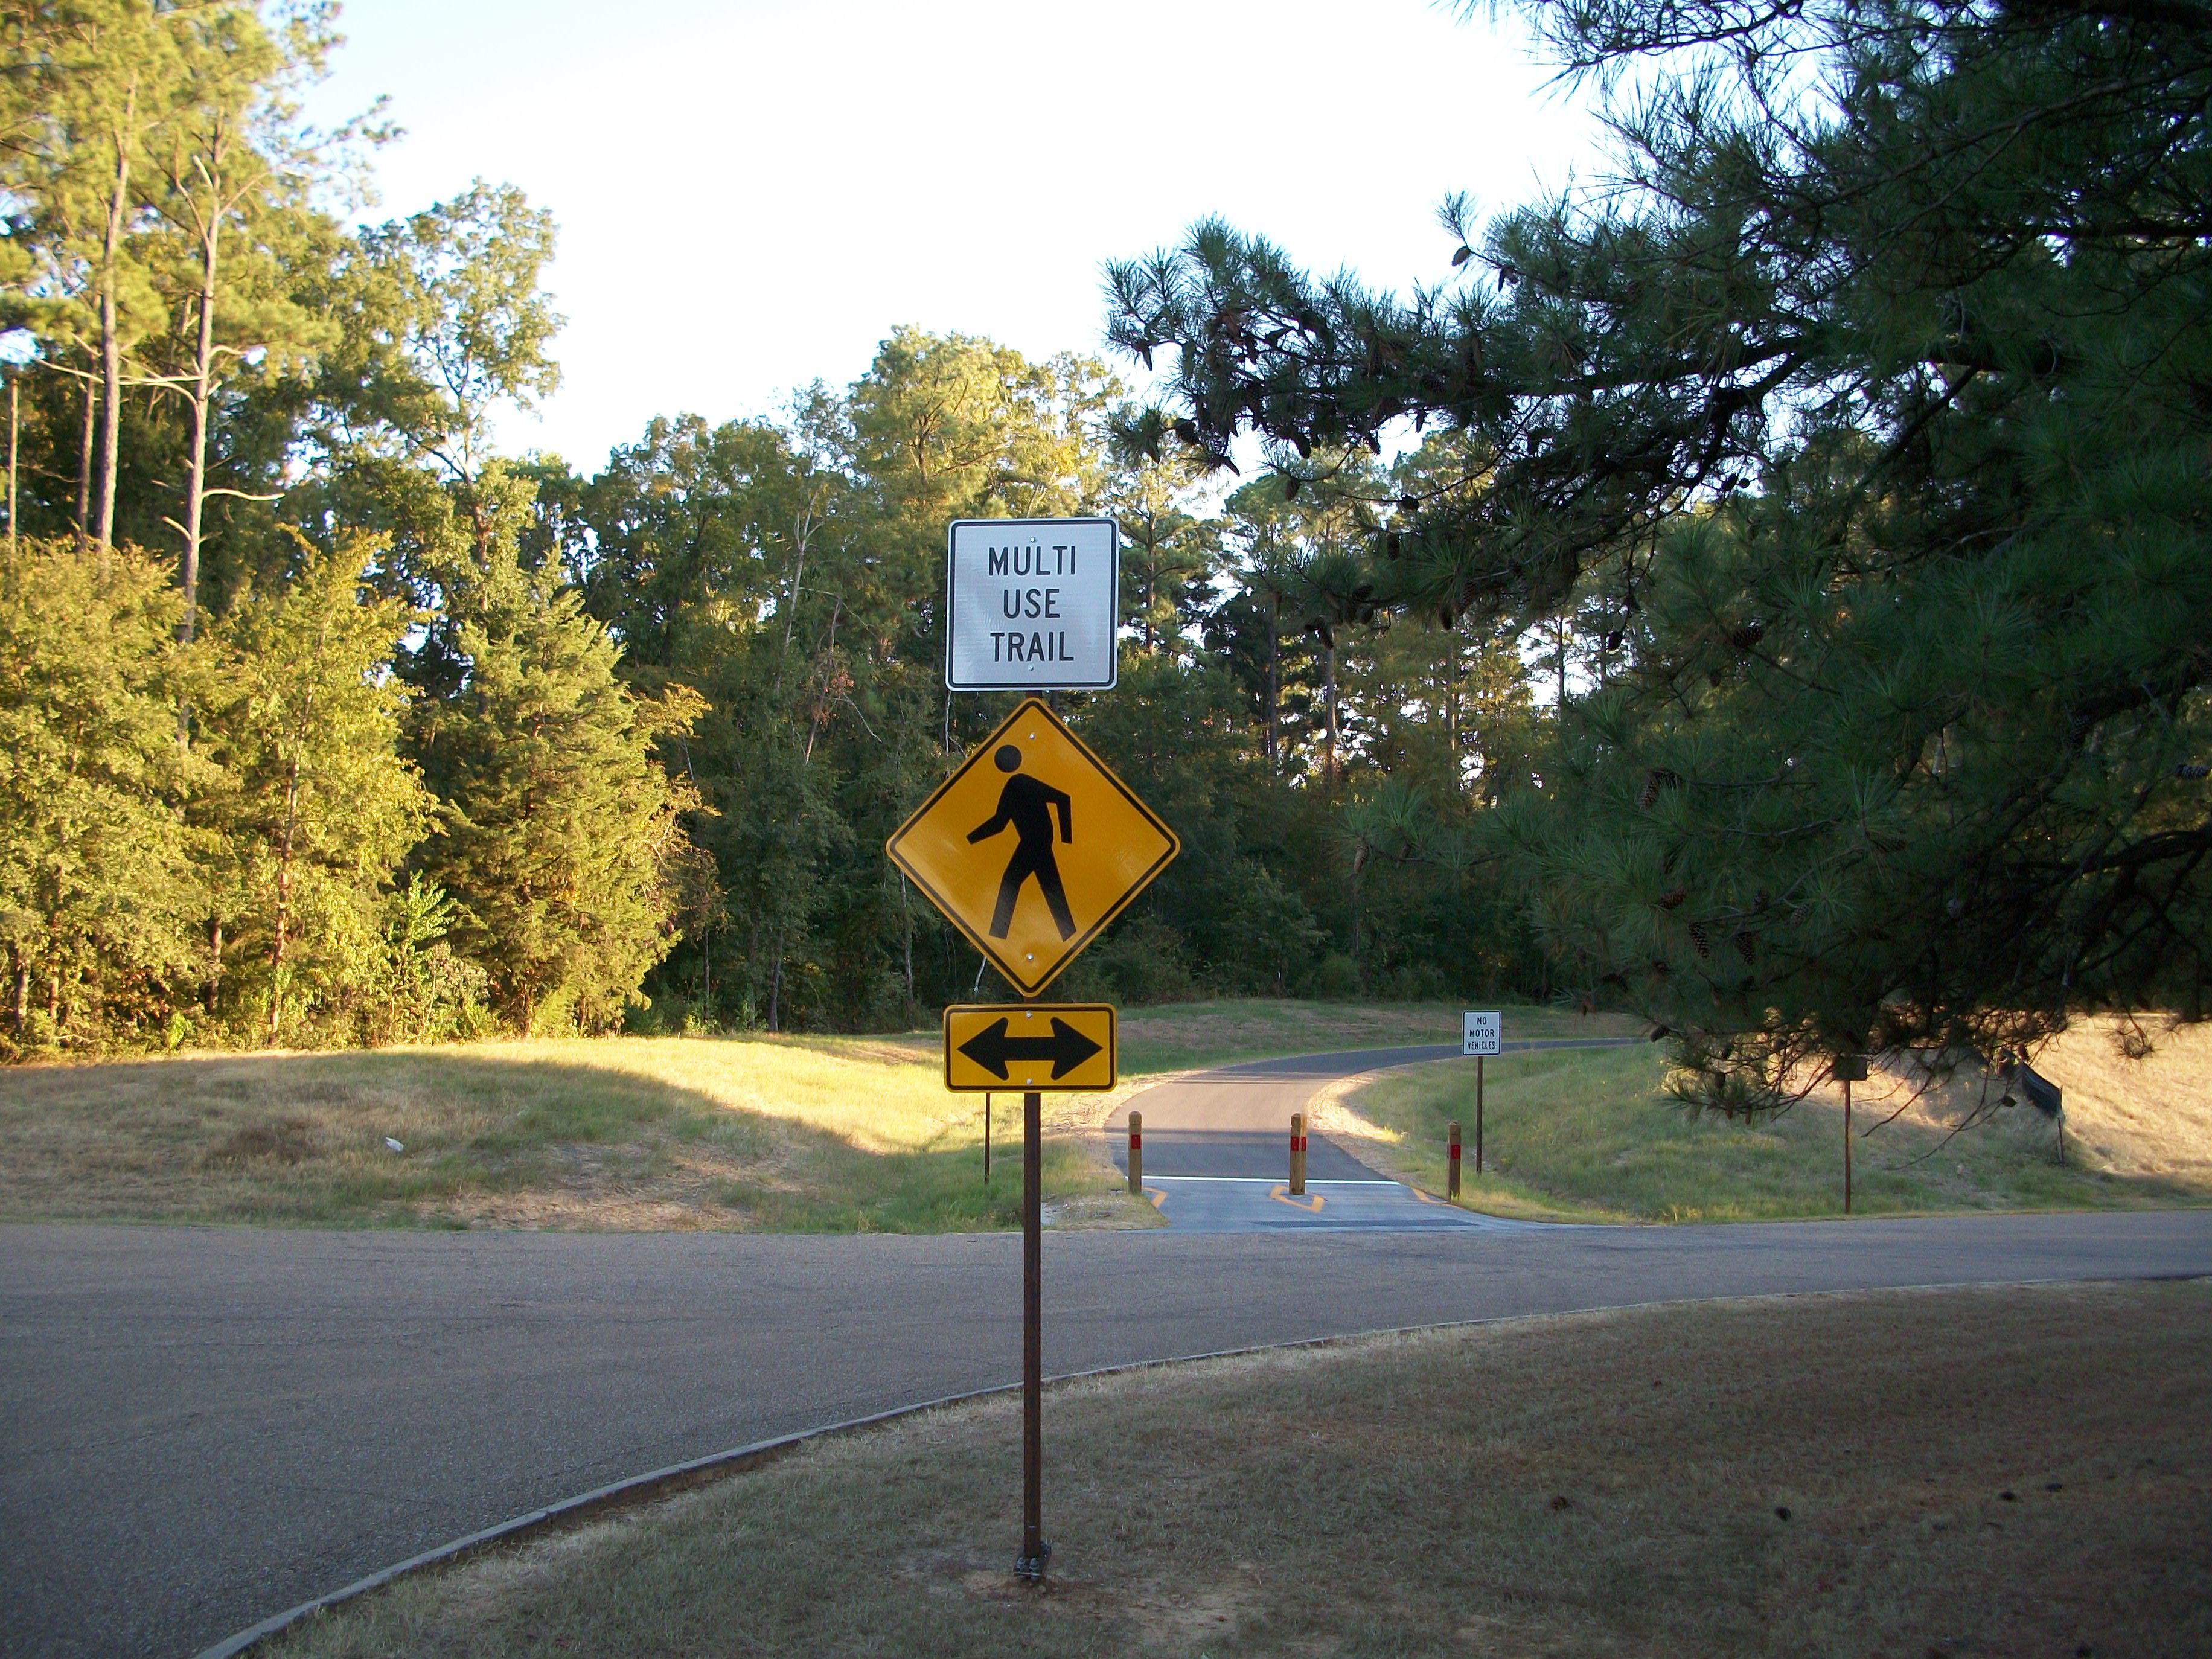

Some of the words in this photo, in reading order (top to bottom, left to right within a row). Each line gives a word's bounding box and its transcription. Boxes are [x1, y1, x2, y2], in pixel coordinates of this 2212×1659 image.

[988, 546, 1076, 576] MULTI
[1003, 589, 1060, 619] USE
[990, 631, 1075, 662] TRAIL
[1468, 1041, 1495, 1050] VEHICLES
[1469, 1029, 1494, 1037] MOTOR
